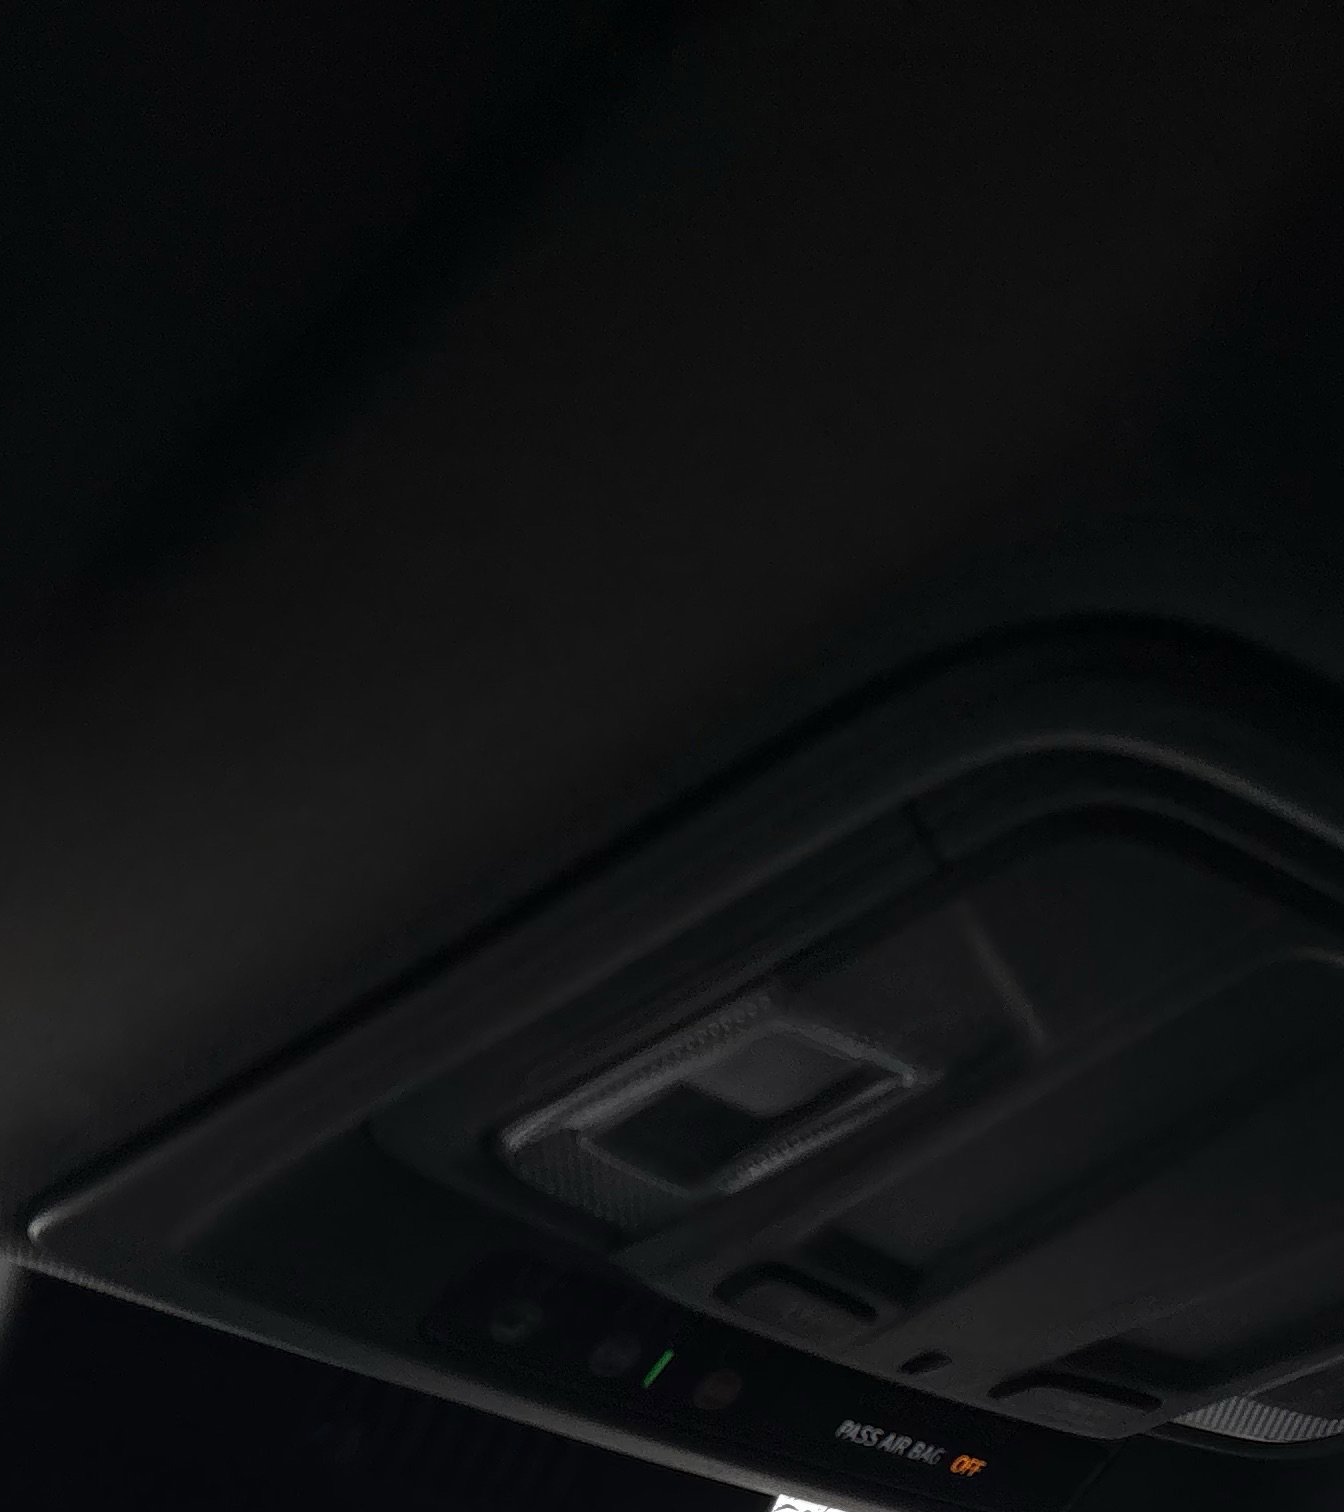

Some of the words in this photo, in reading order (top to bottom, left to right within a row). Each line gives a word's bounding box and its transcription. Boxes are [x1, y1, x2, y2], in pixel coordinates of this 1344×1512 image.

[836, 1419, 884, 1446] PASS
[879, 1433, 913, 1456] AIR
[909, 1442, 946, 1465] BAG
[950, 1454, 988, 1476] OFF
